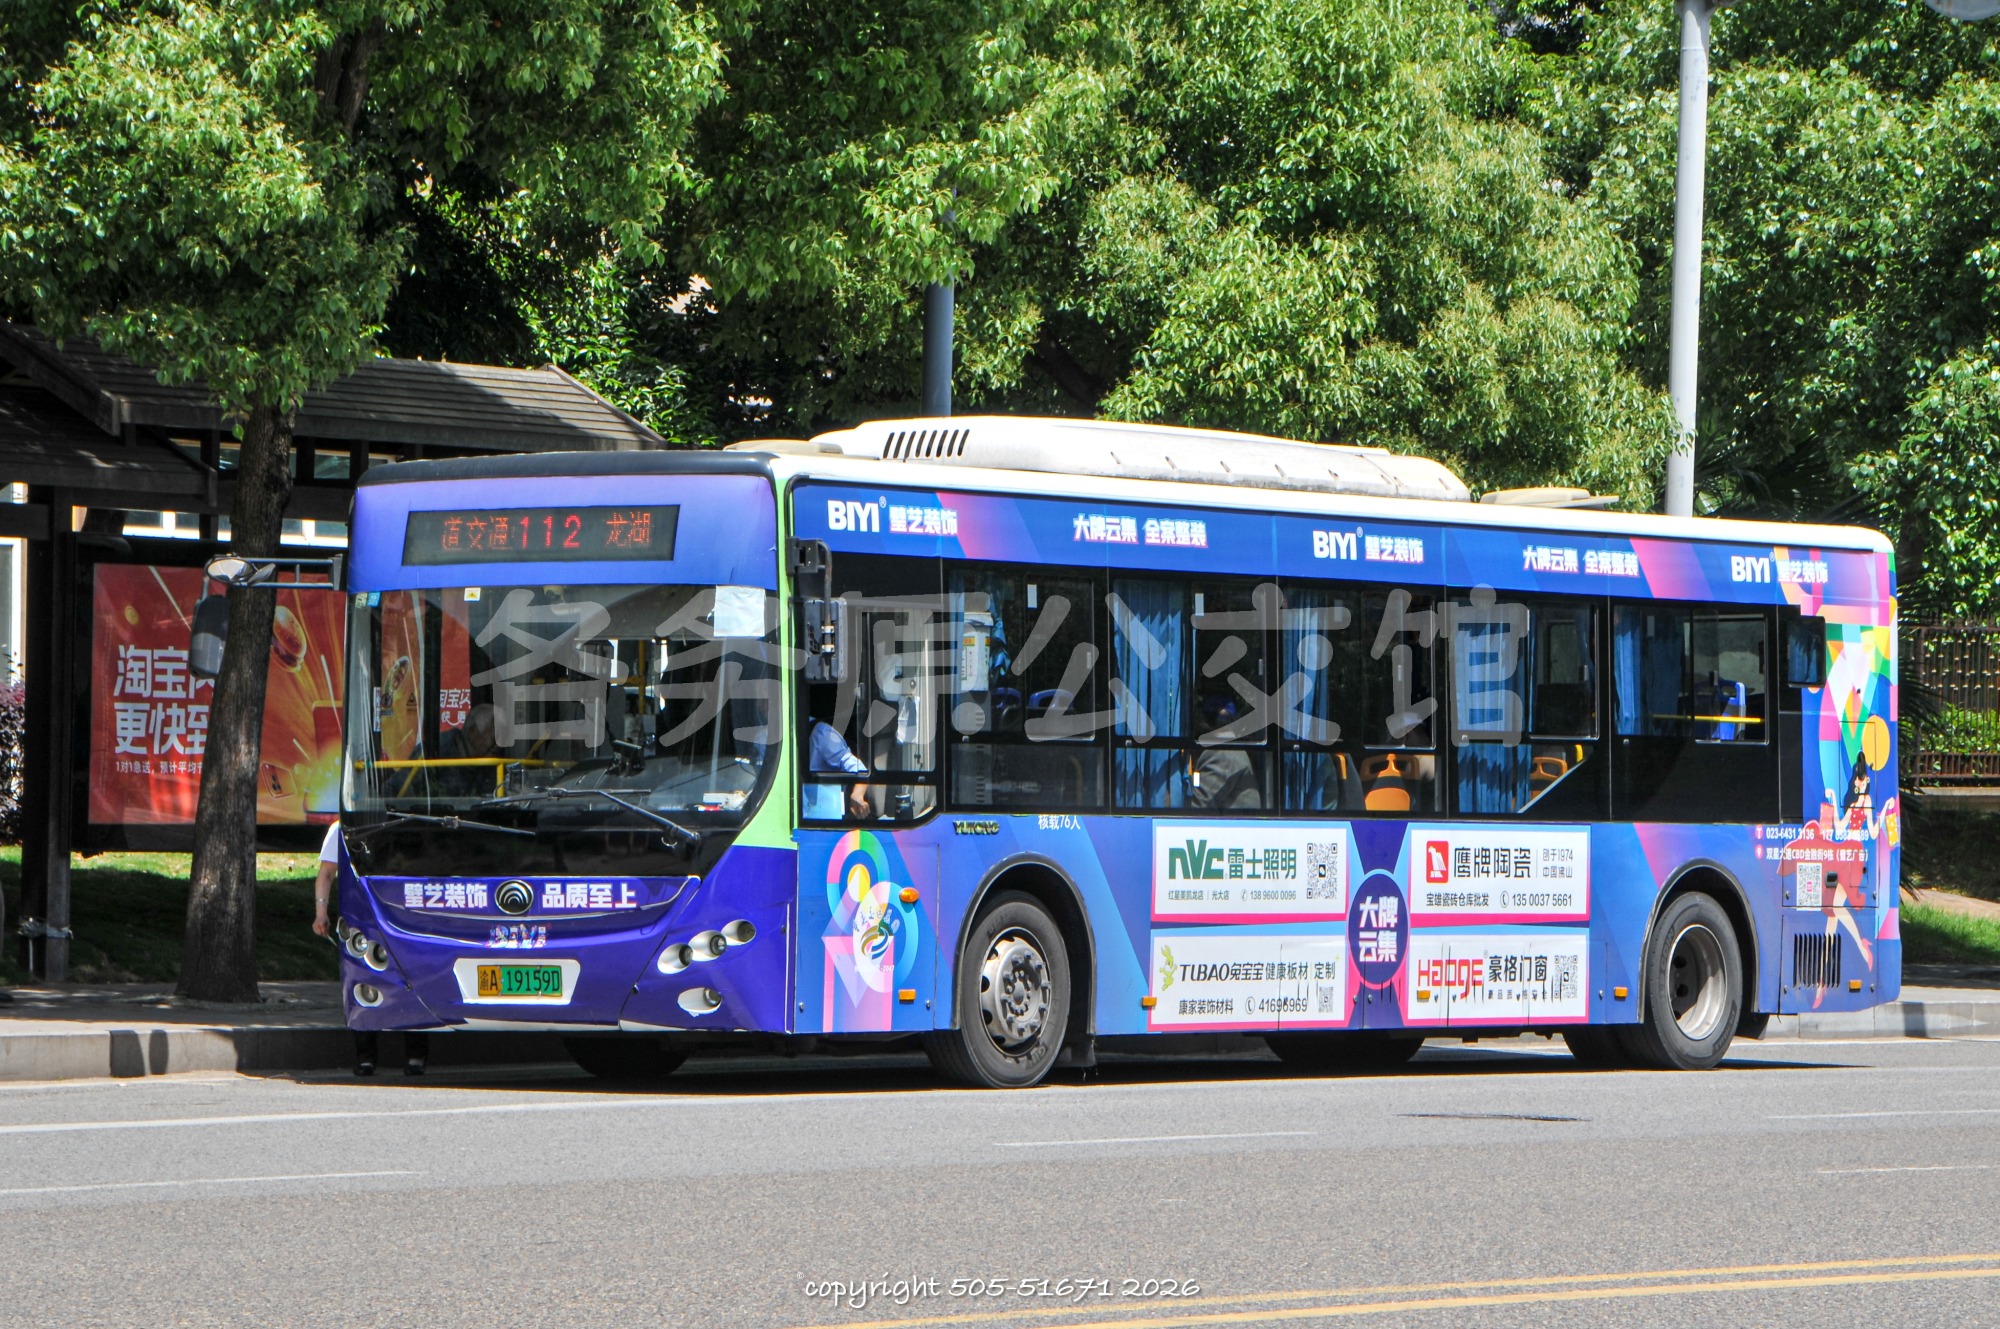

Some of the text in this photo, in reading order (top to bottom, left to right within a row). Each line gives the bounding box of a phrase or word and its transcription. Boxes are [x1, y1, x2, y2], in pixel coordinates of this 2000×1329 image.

[520, 514, 583, 548] 112
[605, 511, 652, 548] 龙湖
[827, 500, 880, 533] BIYI
[1073, 513, 1138, 544] 大牌云集
[1312, 530, 1357, 561] BIYI
[1523, 546, 1579, 574] 大牌云集
[1731, 556, 1770, 583] BIYI
[1228, 849, 1297, 879] 雷士照明
[1453, 847, 1531, 878] 鹰牌陶瓷
[1543, 848, 1573, 862] 创于1974
[542, 883, 637, 908] 品质至上
[1250, 890, 1262, 900] 138
[1426, 893, 1490, 907] 宝雄瓷砖仓库批发
[1512, 894, 1572, 906] 135 0037 5661
[1359, 895, 1399, 929] 大牌
[1359, 930, 1398, 963] 云集
[1314, 962, 1336, 980] 定制
[1489, 955, 1548, 983] 豪格门窗
[1179, 998, 1233, 1014] 康家装饰材料
